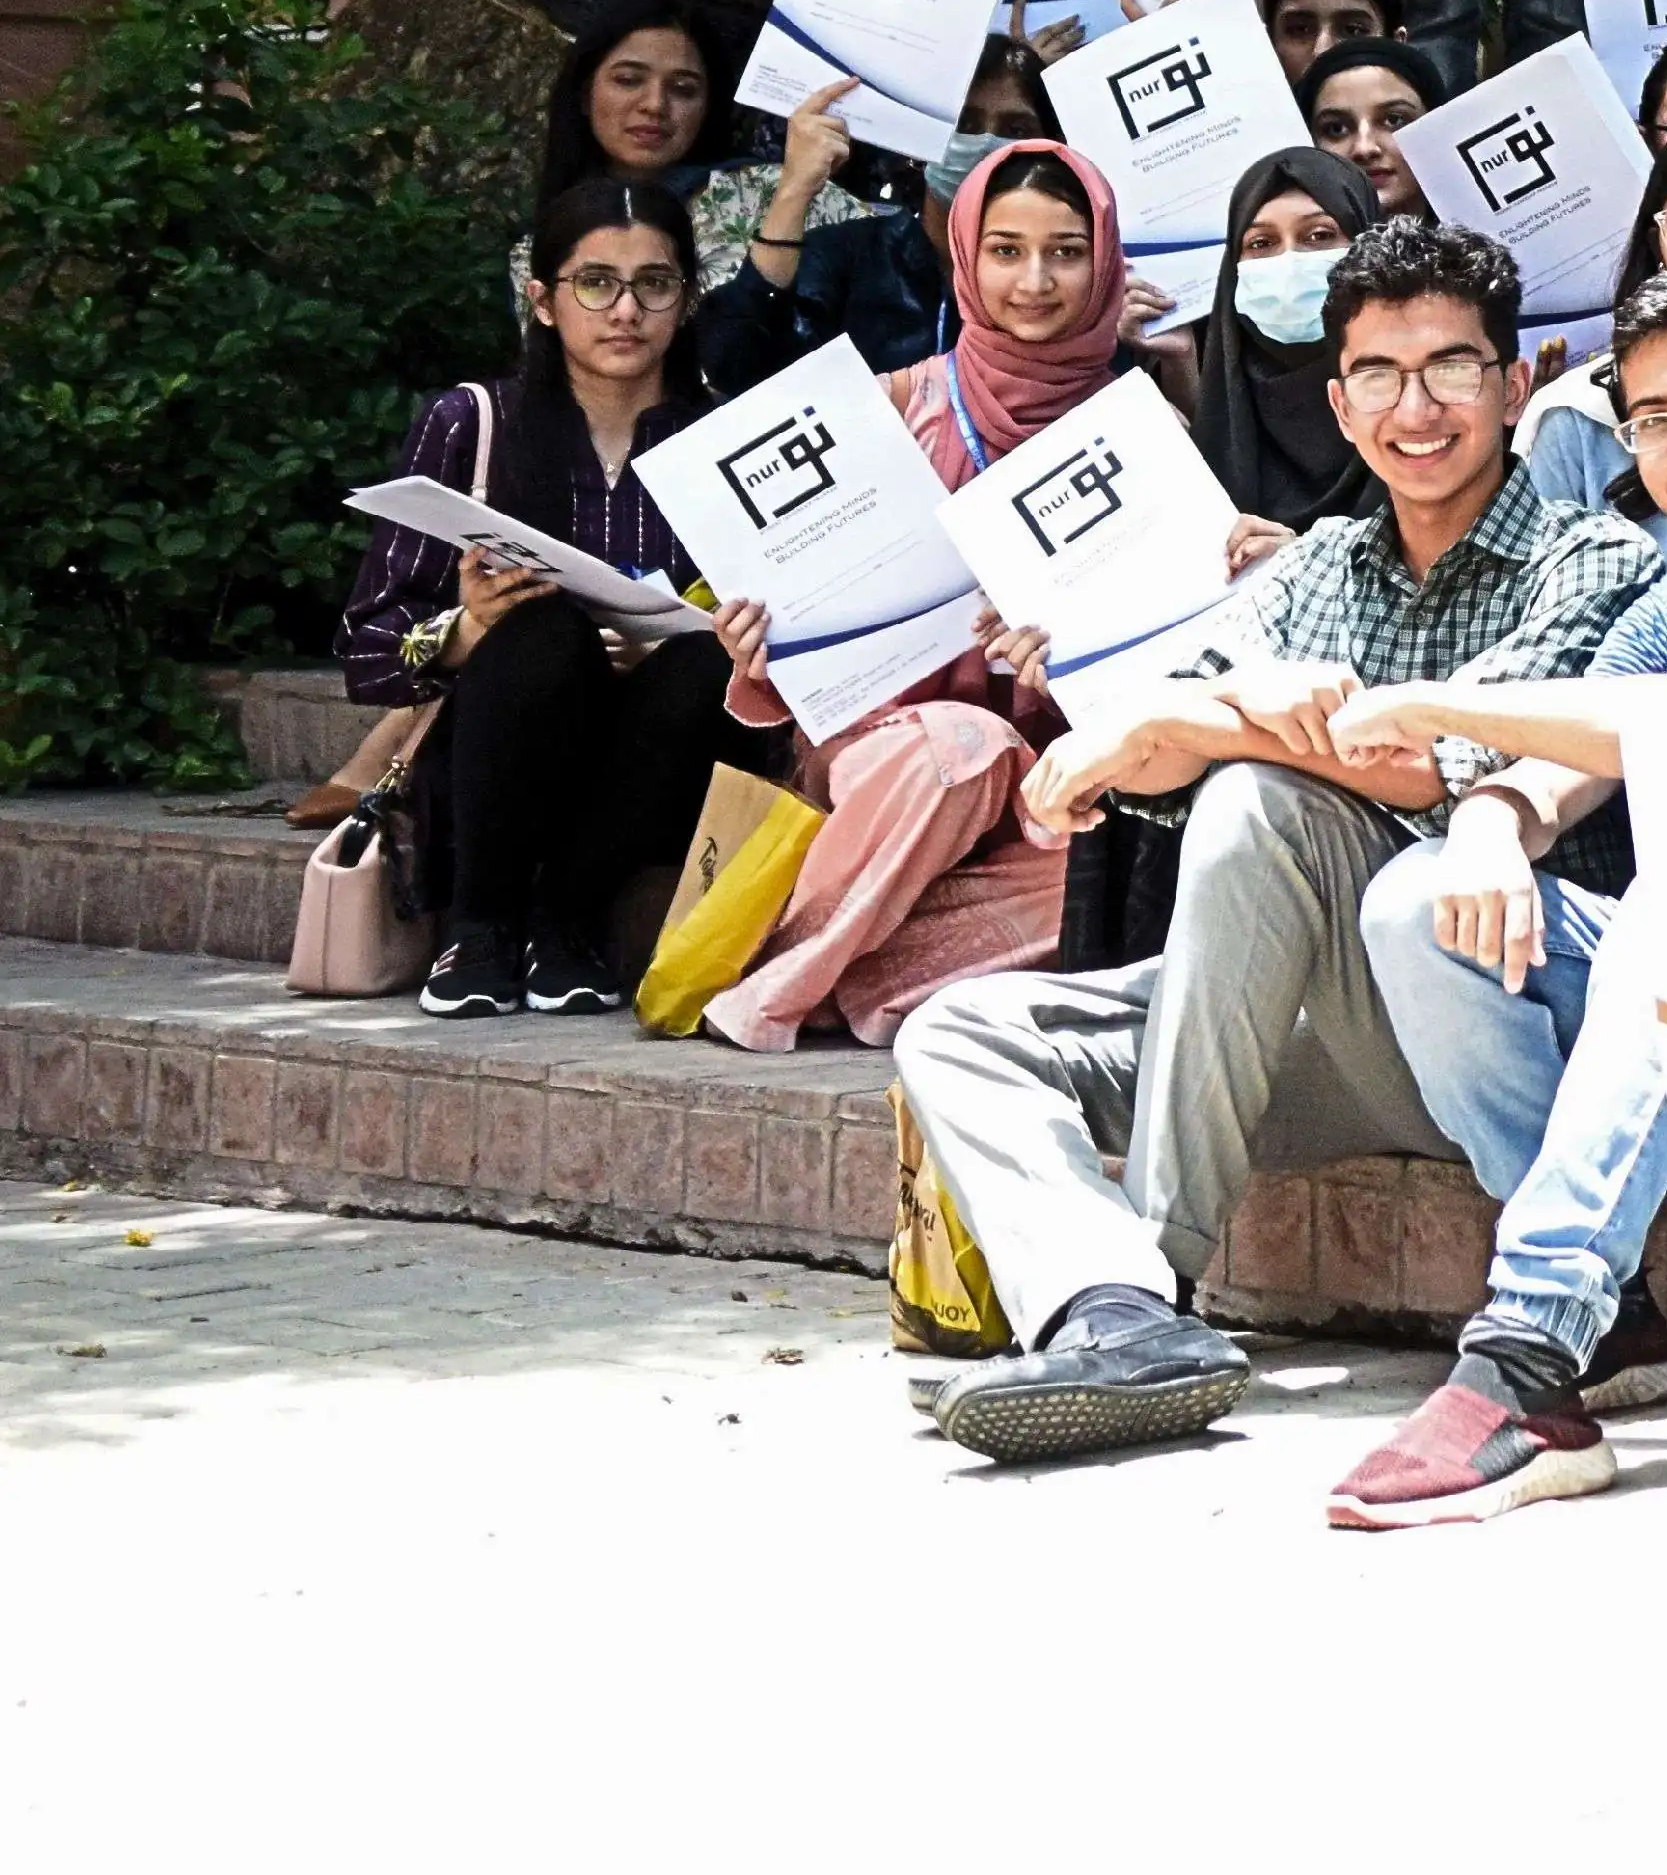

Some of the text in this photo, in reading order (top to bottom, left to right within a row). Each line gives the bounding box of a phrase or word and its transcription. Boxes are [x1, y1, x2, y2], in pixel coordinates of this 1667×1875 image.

[1128, 79, 1160, 104] nur
[1480, 151, 1510, 173] nur
[745, 459, 781, 489] nur
[1039, 490, 1071, 518] nur
